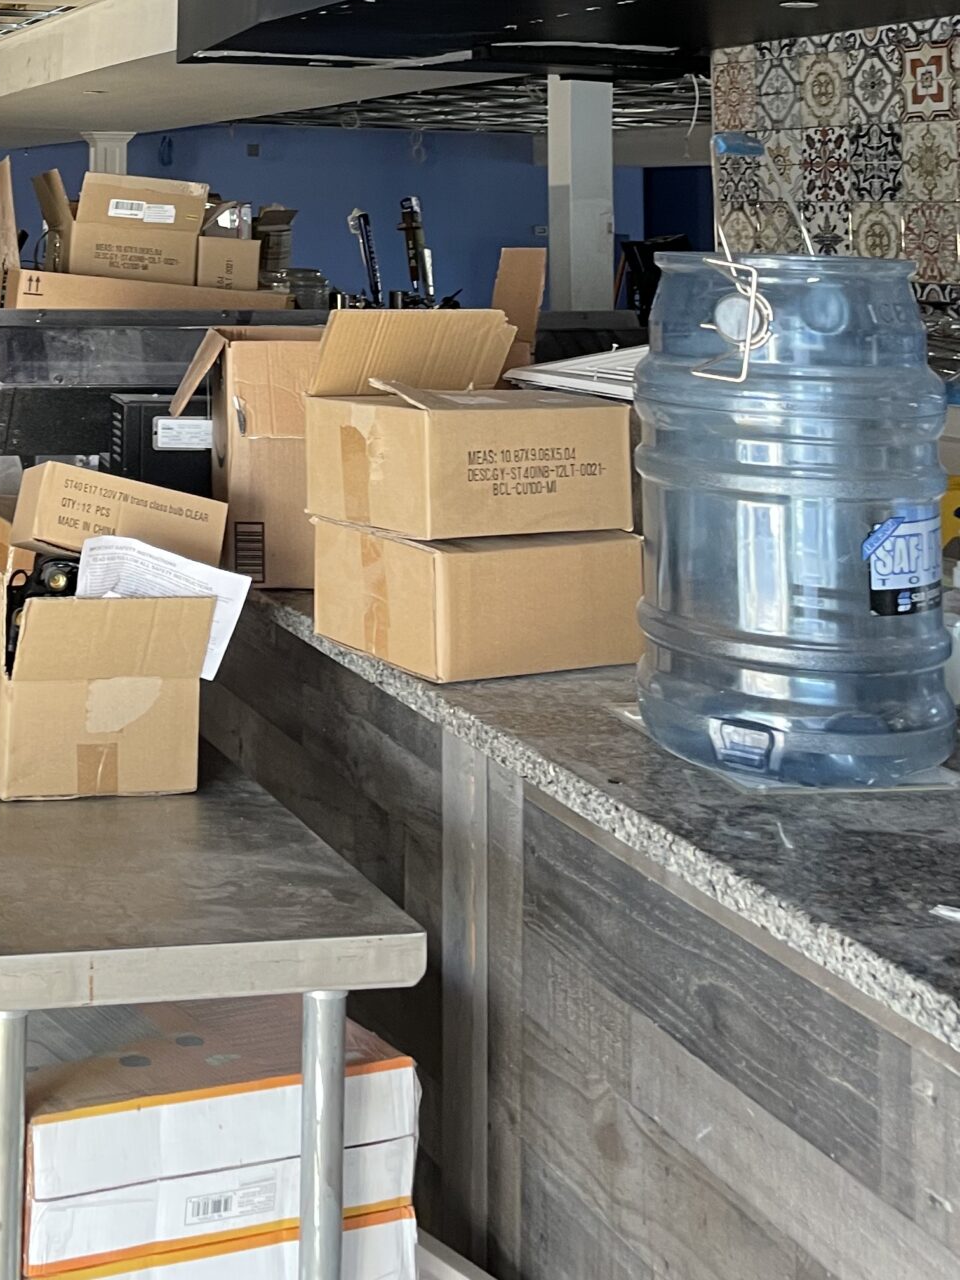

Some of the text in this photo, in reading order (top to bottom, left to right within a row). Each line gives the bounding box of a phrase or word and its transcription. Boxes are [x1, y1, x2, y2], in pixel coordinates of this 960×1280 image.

[467, 449, 498, 465] MEAS:
[63, 478, 83, 492] ST40
[83, 482, 98, 495] E17
[98, 486, 117, 500] 120V
[117, 491, 129, 503] 7W
[168, 503, 184, 517] bulb
[184, 508, 209, 523] CLEAR
[95, 505, 112, 518] PCS
[57, 515, 116, 536] MADE IN CHINA
